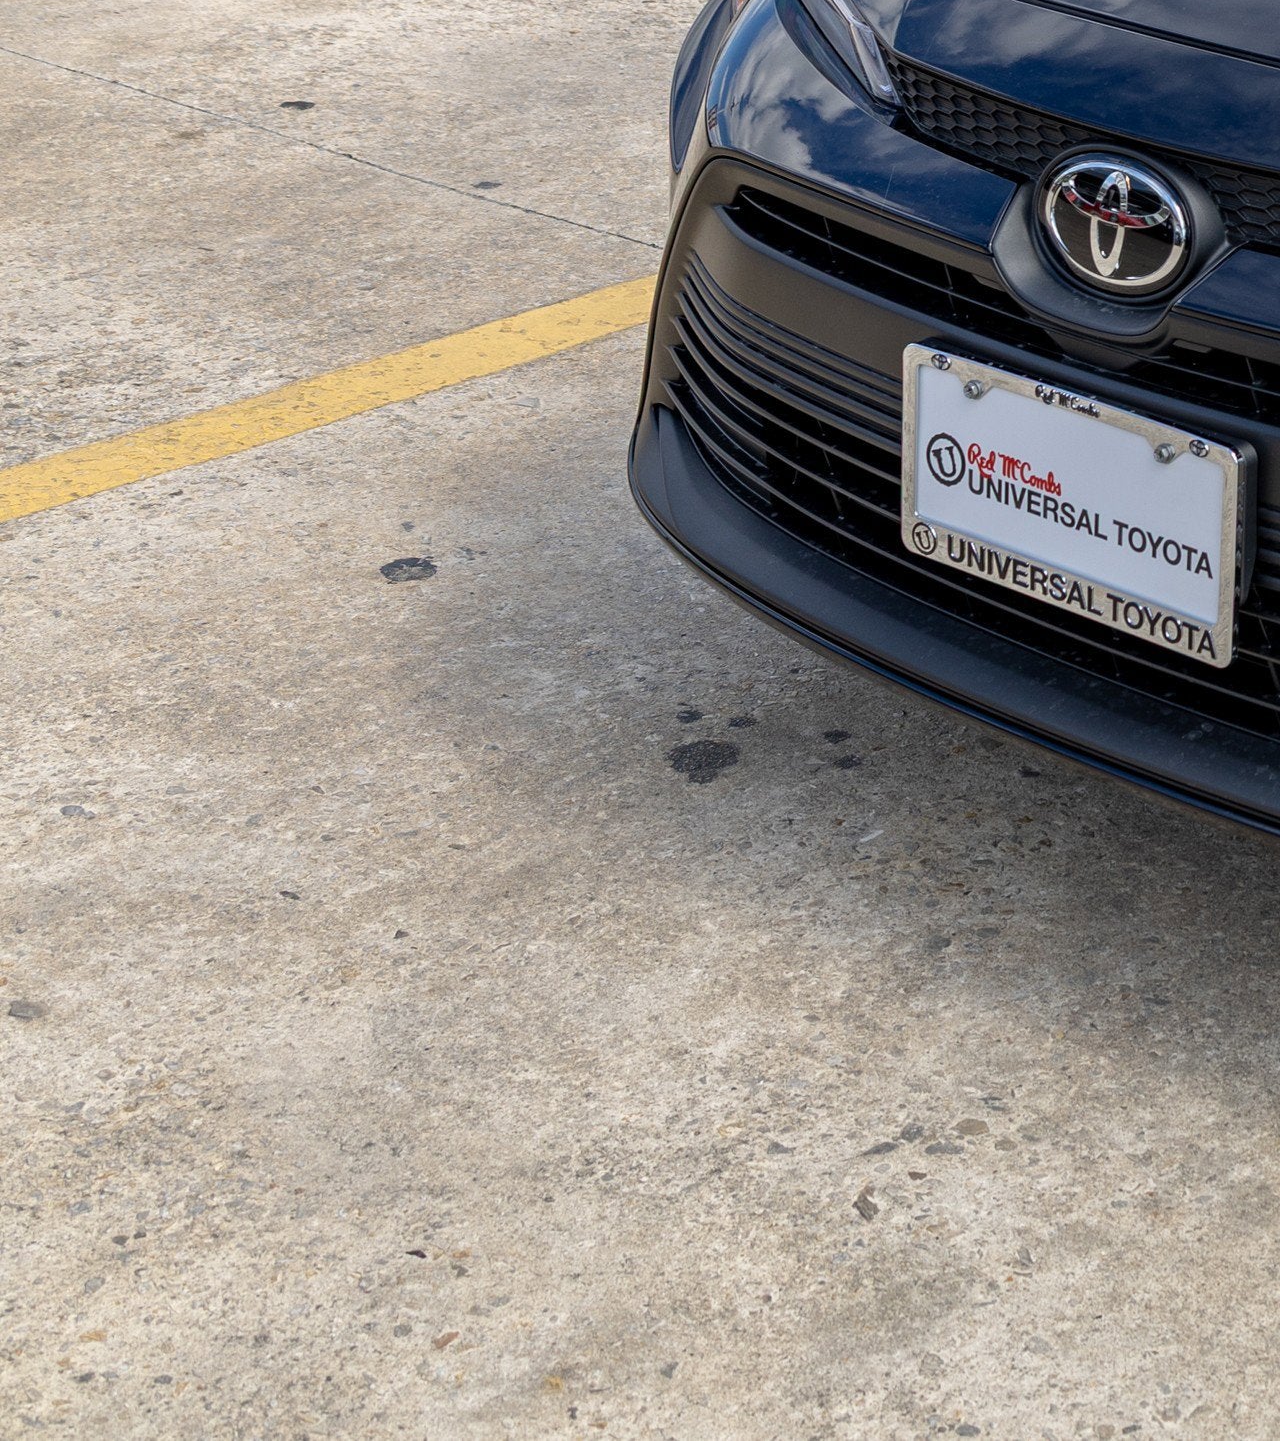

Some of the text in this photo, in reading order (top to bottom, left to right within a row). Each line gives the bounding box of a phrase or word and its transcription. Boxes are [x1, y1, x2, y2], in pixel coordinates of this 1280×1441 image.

[1034, 384, 1100, 419] Red McCombs
[967, 443, 1062, 497] Red McCombs
[967, 469, 1214, 580] UNIVERSAL TOYOTA
[947, 534, 1104, 615] UNIVERSAL
[1107, 593, 1217, 660] TOYOTA
